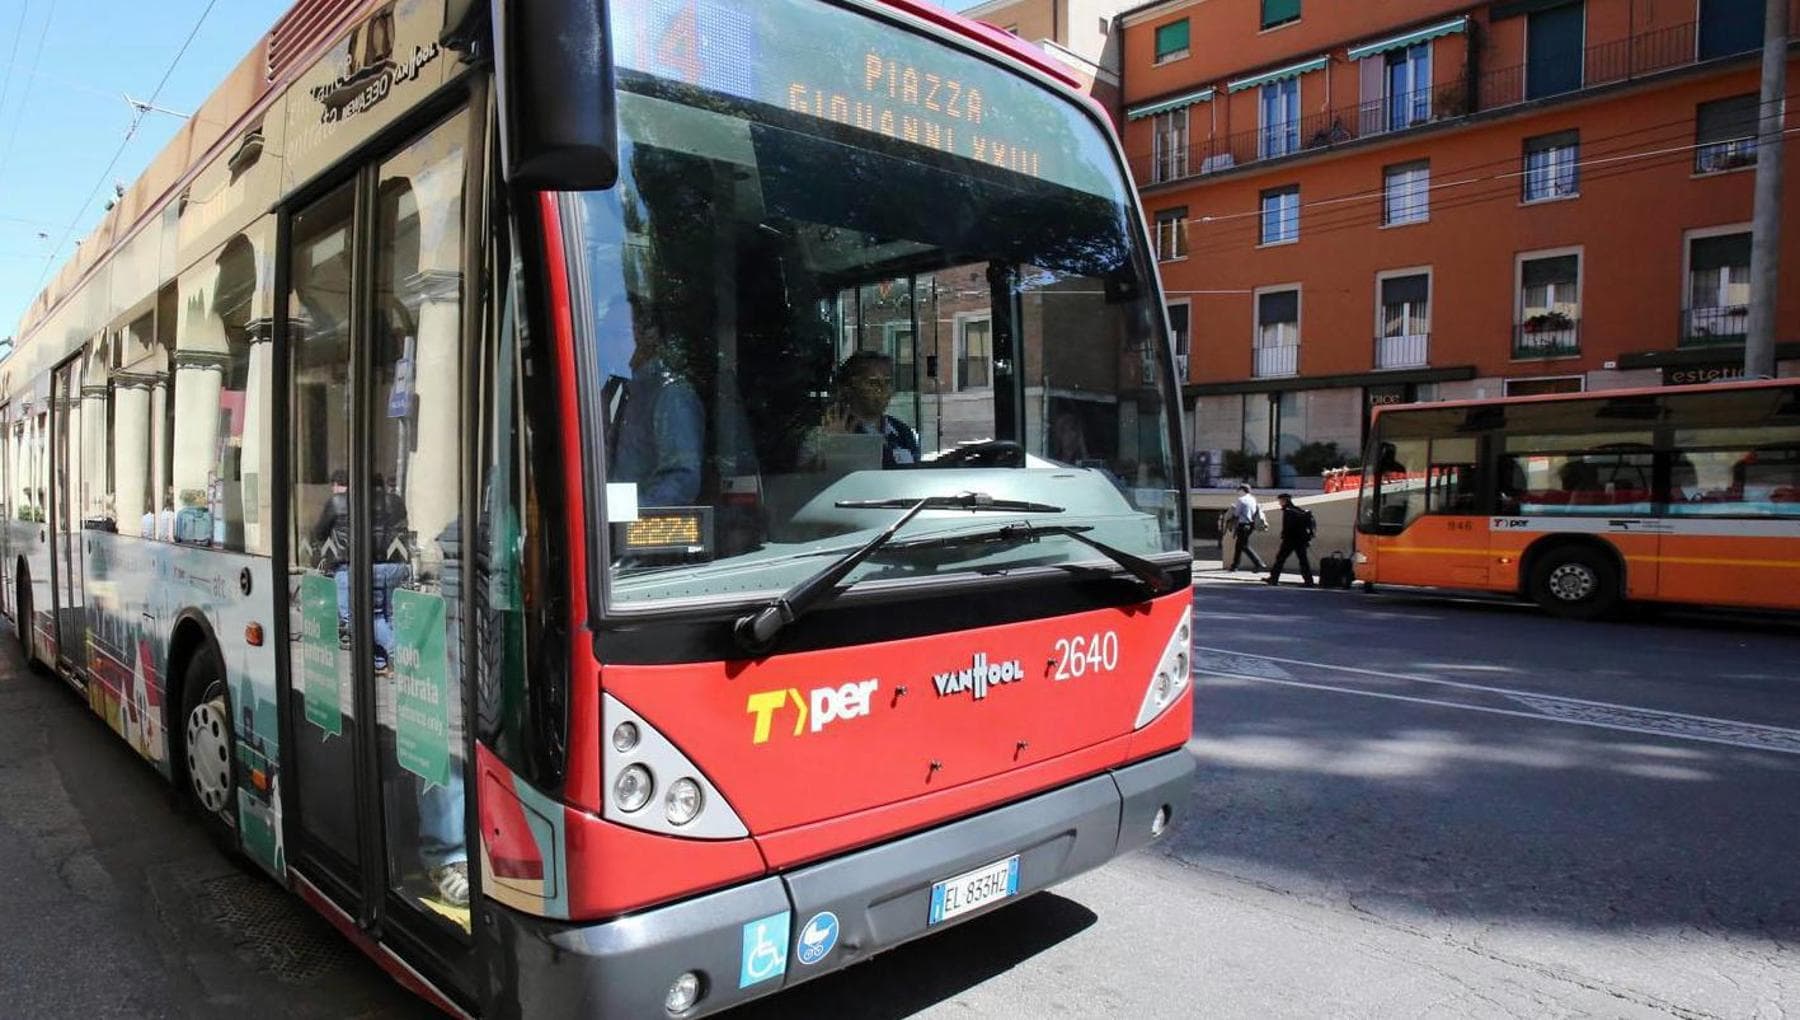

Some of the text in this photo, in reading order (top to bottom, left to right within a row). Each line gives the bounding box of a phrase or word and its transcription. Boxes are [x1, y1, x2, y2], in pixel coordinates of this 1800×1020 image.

[866, 53, 982, 124] PIAZZA
[627, 517, 698, 545] 2274
[396, 643, 420, 674] solo
[1054, 630, 1119, 682] 2640
[397, 670, 439, 704] entrata
[944, 886, 961, 912] EL
[966, 869, 1008, 904] 833HZ
